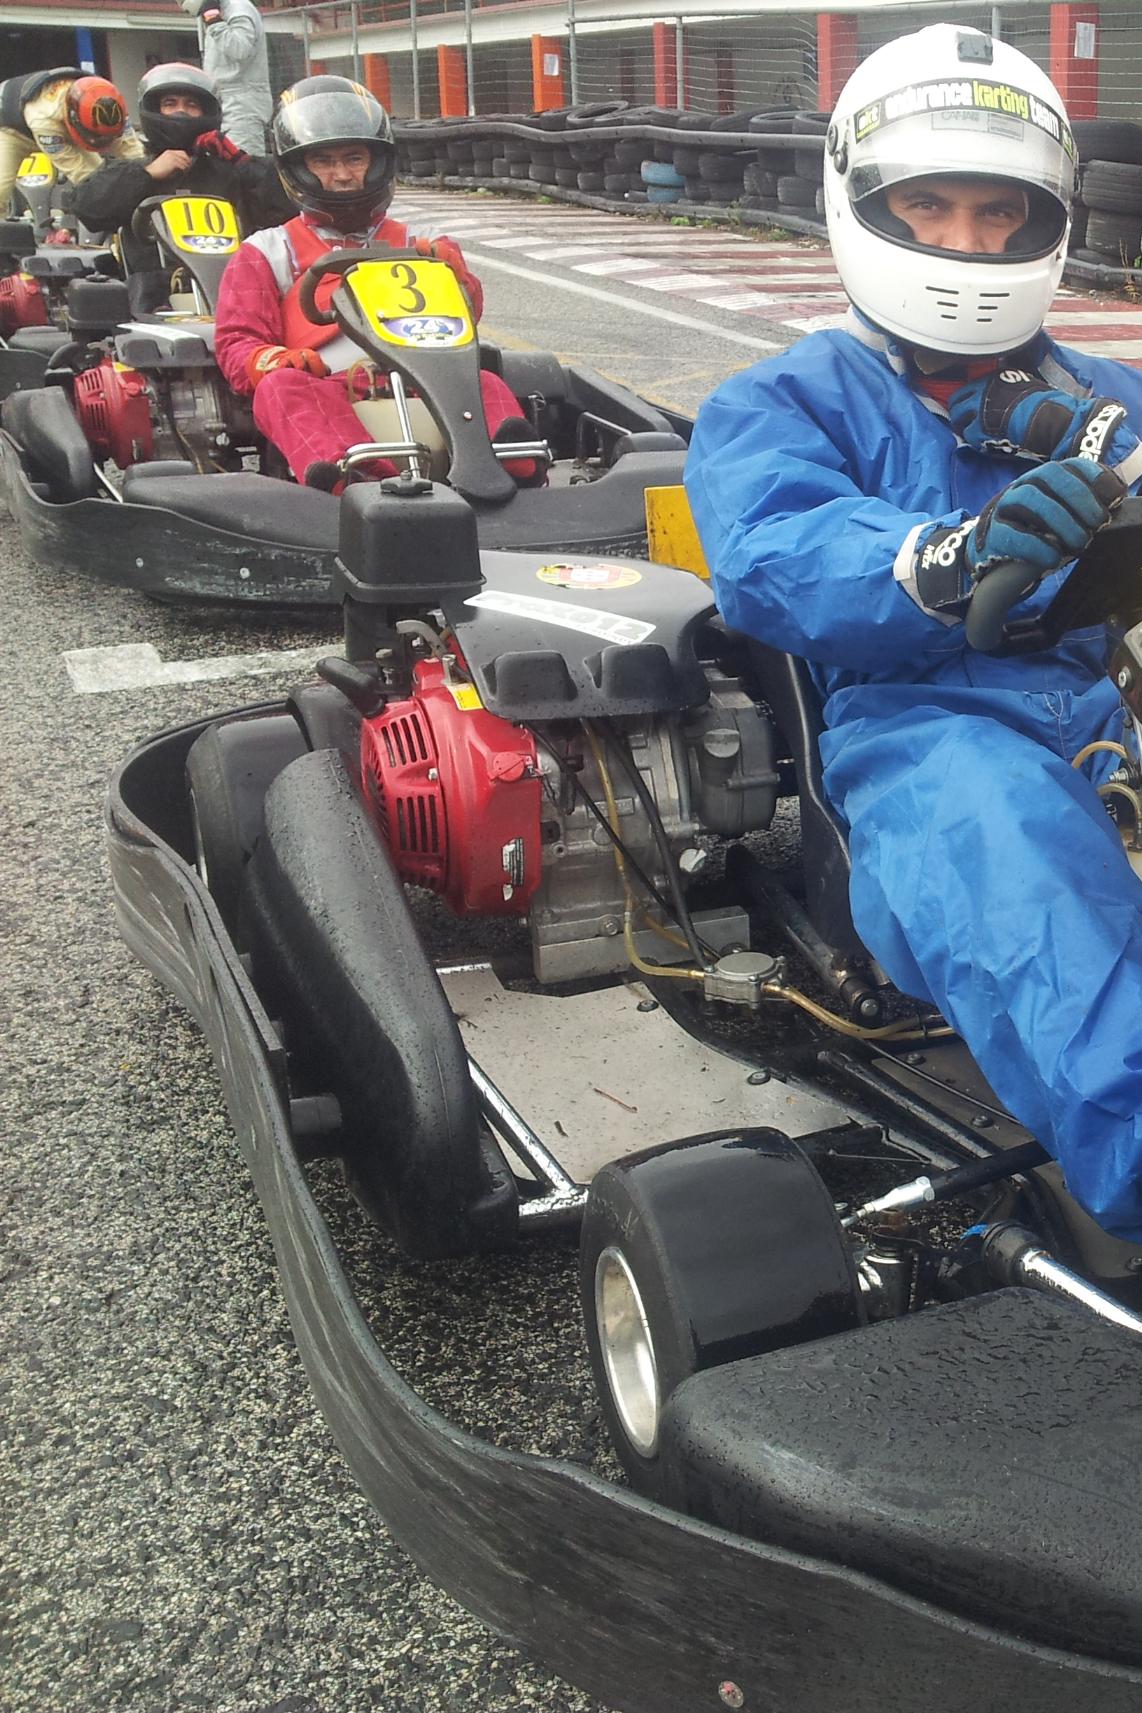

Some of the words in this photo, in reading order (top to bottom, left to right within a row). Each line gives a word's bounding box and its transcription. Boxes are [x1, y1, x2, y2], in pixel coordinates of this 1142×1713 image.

[884, 82, 973, 121] endurance
[972, 81, 1029, 120] karting
[1029, 95, 1060, 140] team
[182, 202, 225, 234] 10
[390, 263, 426, 313] 3
